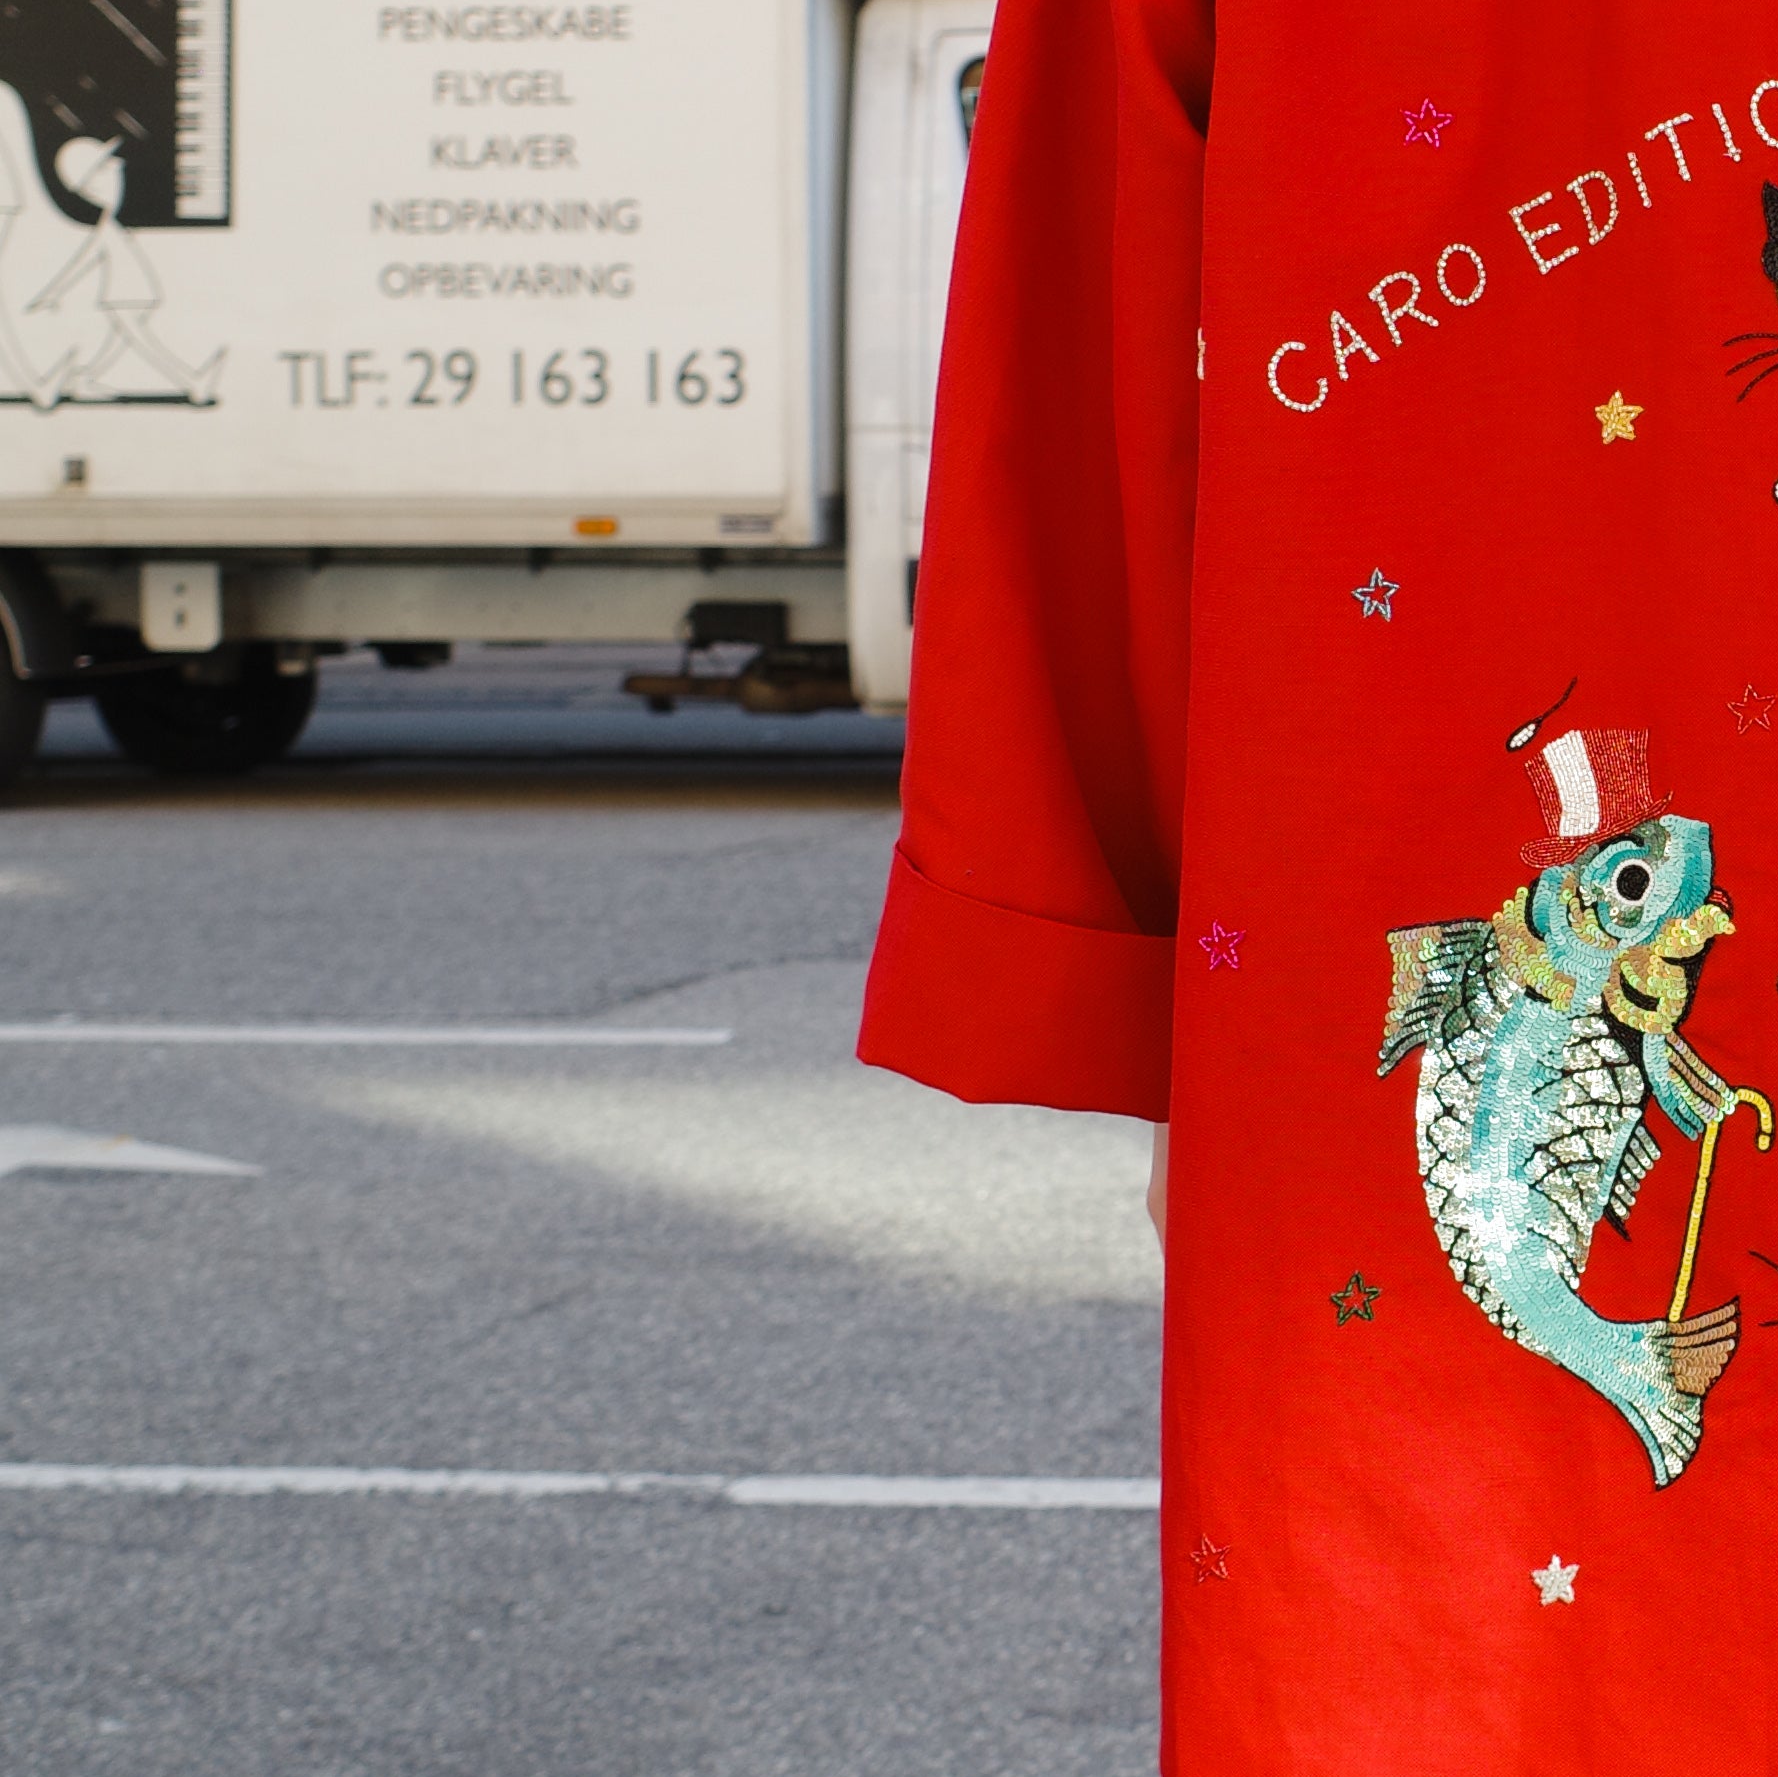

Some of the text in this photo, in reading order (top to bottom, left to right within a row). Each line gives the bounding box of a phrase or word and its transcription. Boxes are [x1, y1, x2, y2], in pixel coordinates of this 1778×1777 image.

[376, 5, 634, 42] PENGESKABE
[431, 69, 576, 106] FLYGEL
[428, 133, 580, 170] KLAVER
[370, 198, 642, 236] NEDPAKNING
[377, 261, 636, 300] OPBEVARING
[1266, 242, 1487, 413] CARO
[277, 347, 746, 408] TLF: 29 163 163
